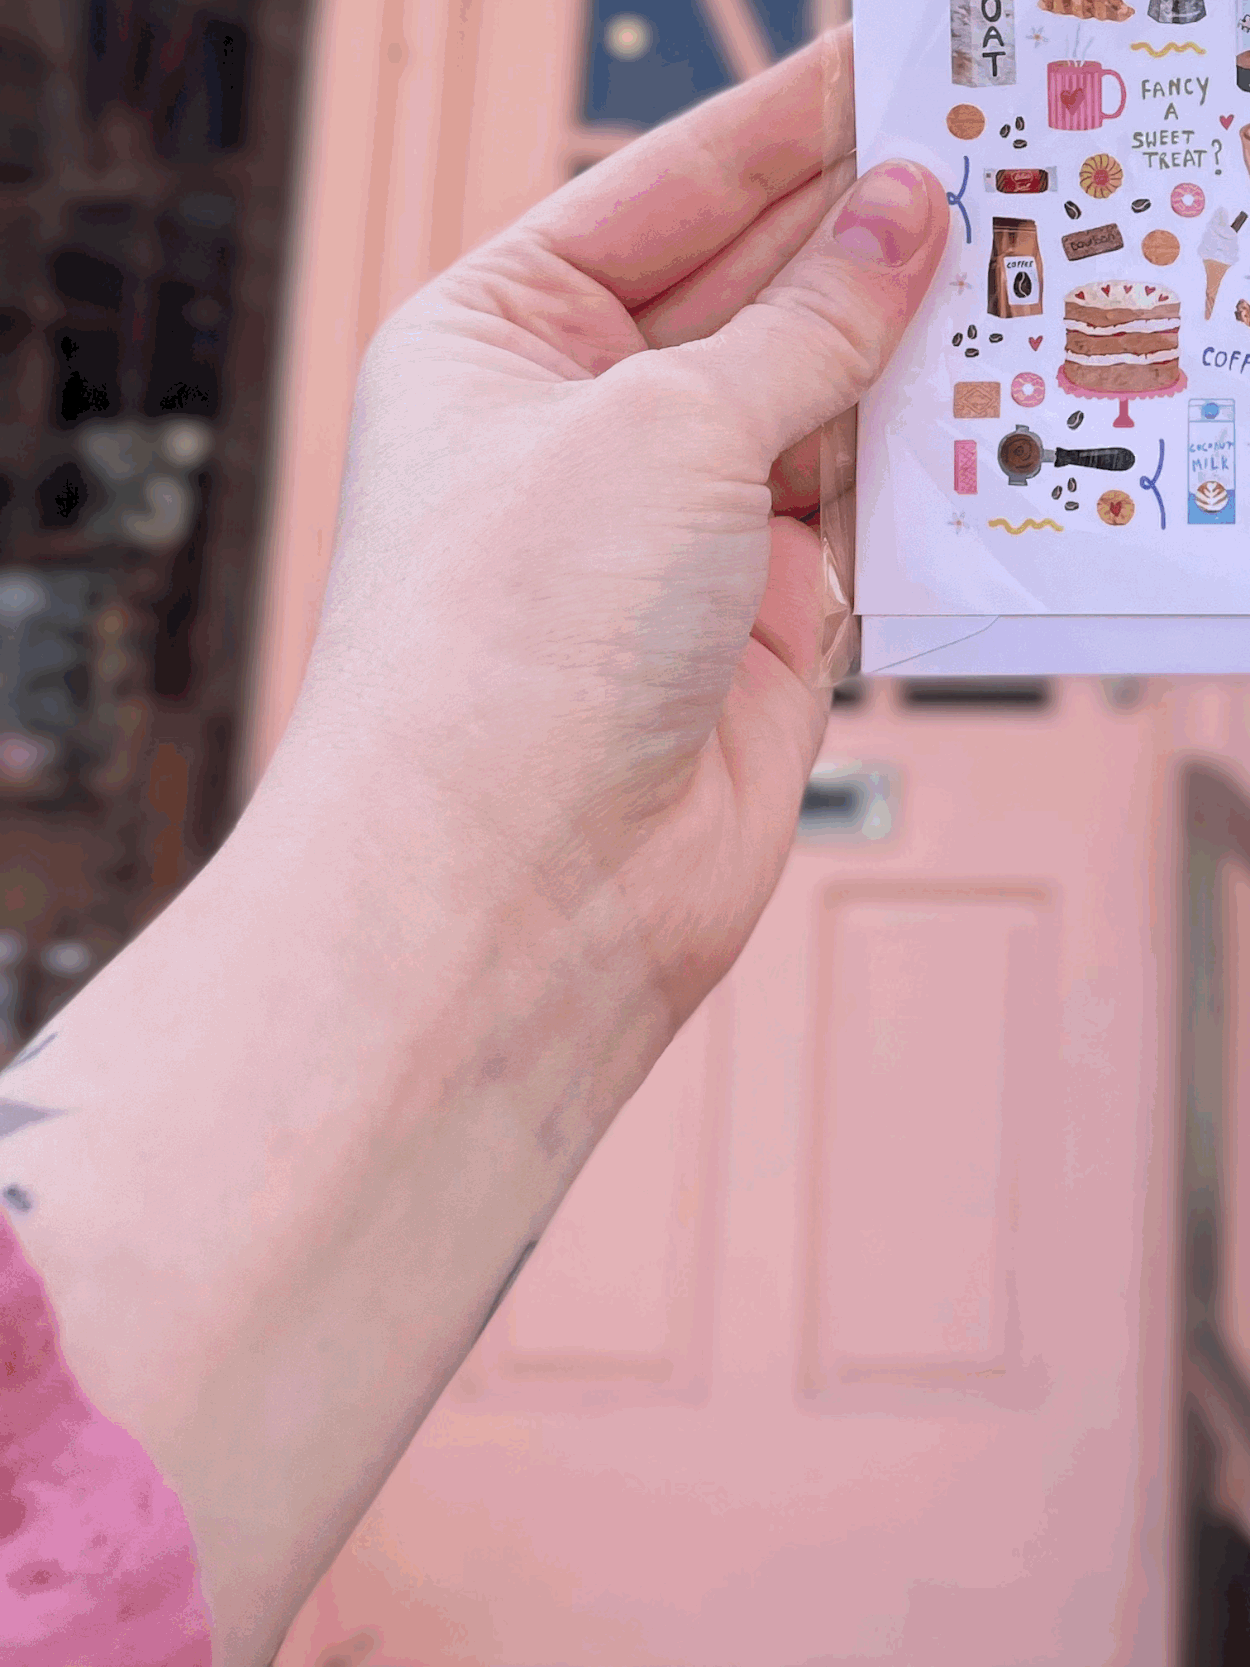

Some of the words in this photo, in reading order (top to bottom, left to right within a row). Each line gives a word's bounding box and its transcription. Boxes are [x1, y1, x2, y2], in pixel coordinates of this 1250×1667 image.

[1141, 77, 1209, 106] FANCY
[1163, 102, 1179, 120] A
[1131, 129, 1195, 149] SWEET
[1006, 259, 1034, 269] COFFEE
[1190, 440, 1234, 453] COCONUT
[1192, 454, 1229, 472] MILK
